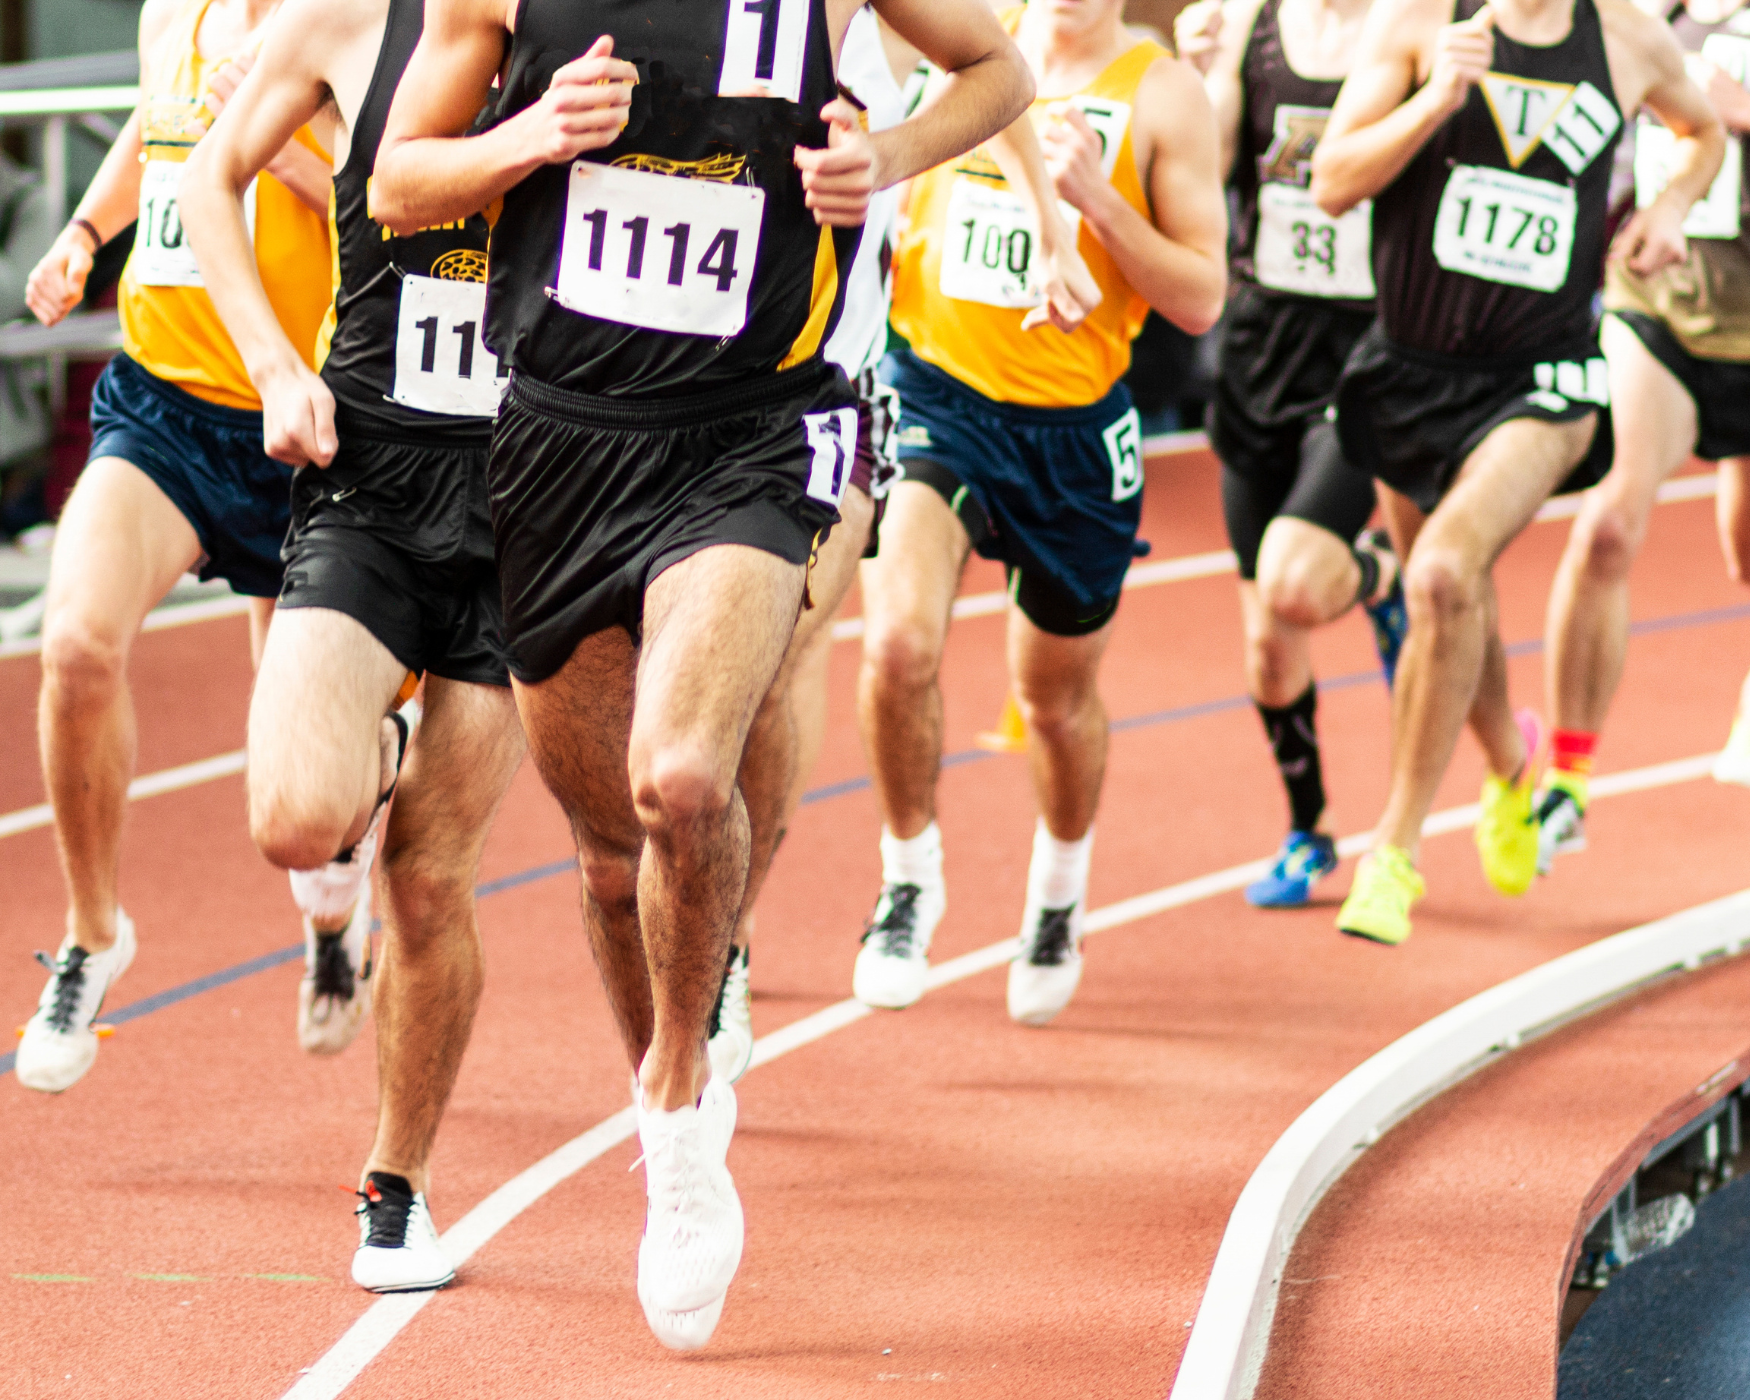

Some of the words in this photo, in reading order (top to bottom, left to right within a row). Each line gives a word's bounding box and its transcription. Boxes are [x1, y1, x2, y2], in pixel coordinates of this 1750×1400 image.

[744, 0, 780, 80] 1
[1505, 84, 1546, 136] T
[1553, 101, 1606, 158] 11
[146, 198, 191, 248] 10
[583, 208, 739, 292] 1114
[1458, 197, 1558, 256] 1178
[818, 412, 846, 497] 1
[1115, 422, 1137, 489] 5
